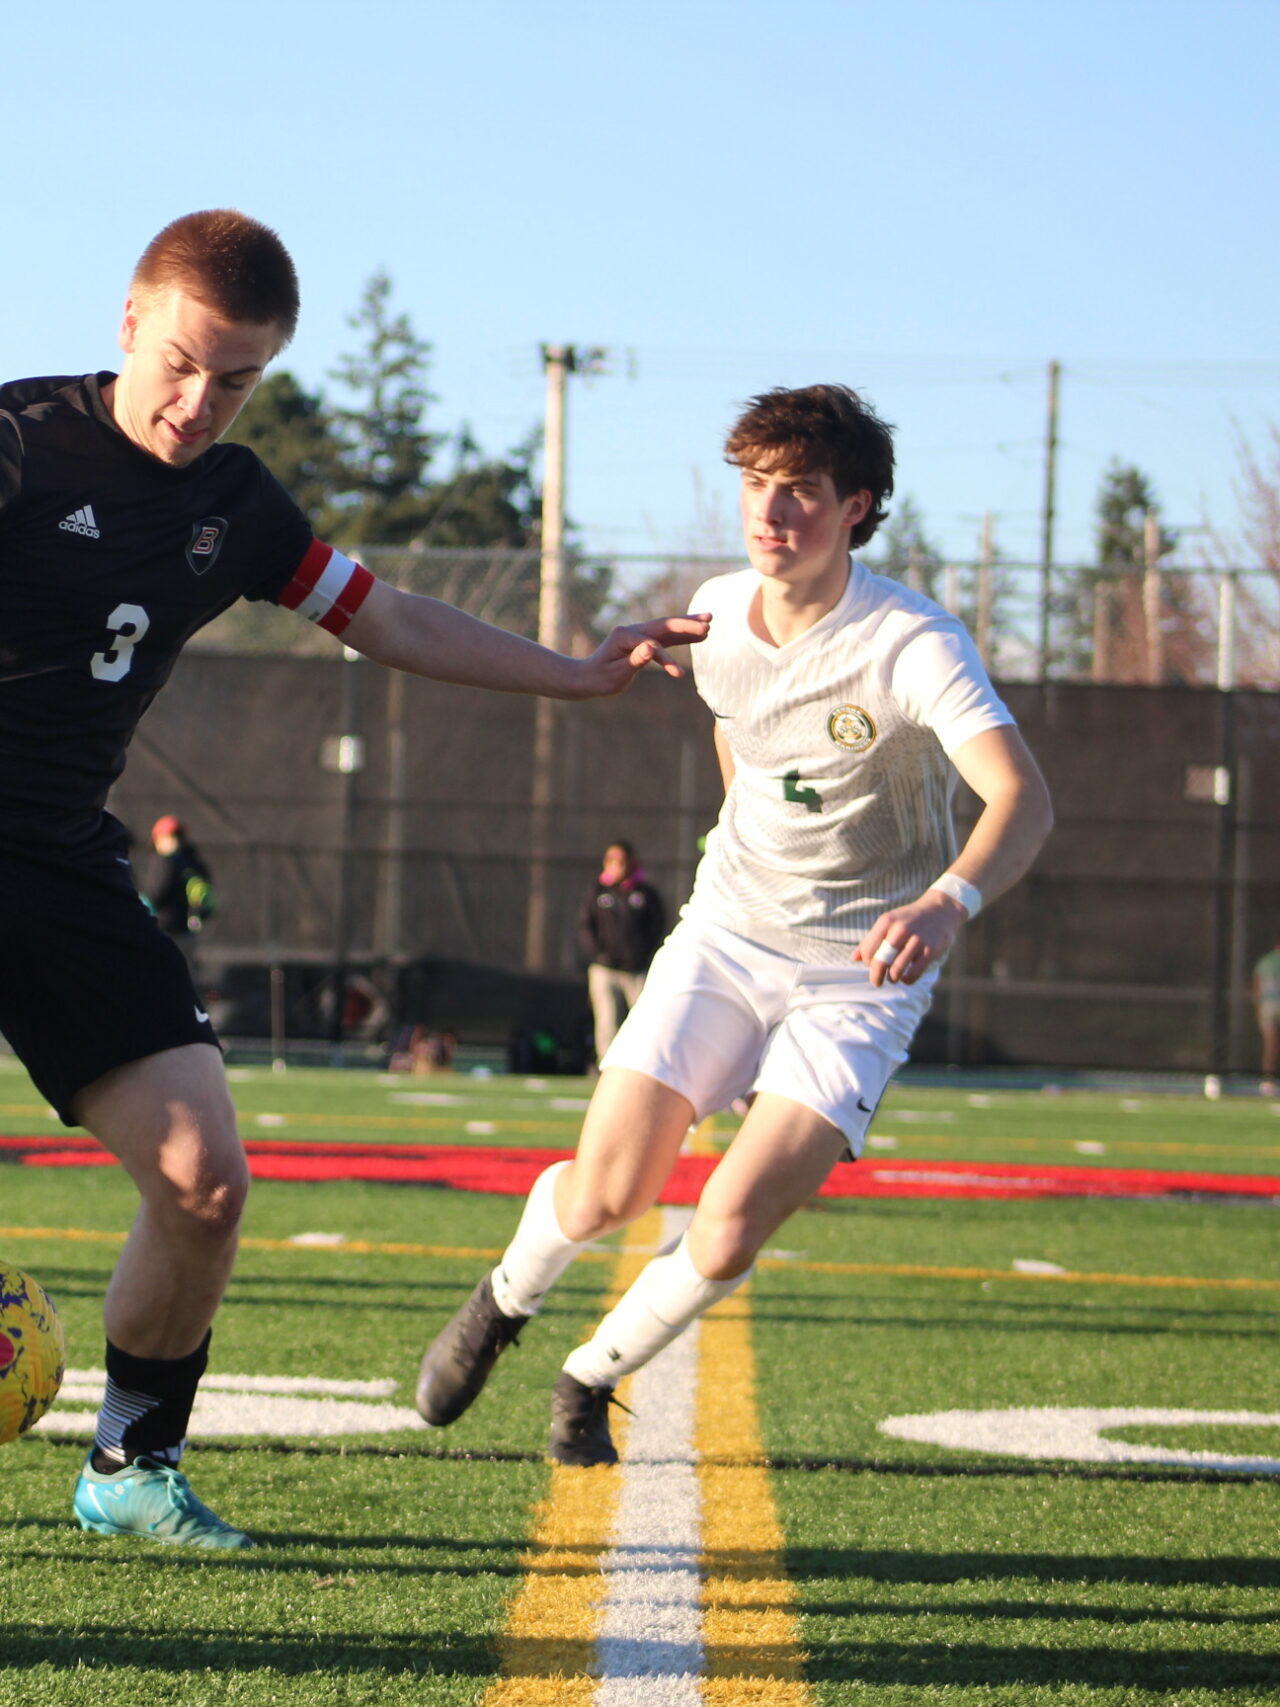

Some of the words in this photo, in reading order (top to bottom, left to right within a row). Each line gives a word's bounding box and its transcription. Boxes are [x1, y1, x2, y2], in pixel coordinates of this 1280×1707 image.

[58, 520, 100, 539] adidas
[192, 527, 219, 554] B
[90, 603, 150, 682] 3
[783, 768, 823, 813] 4
